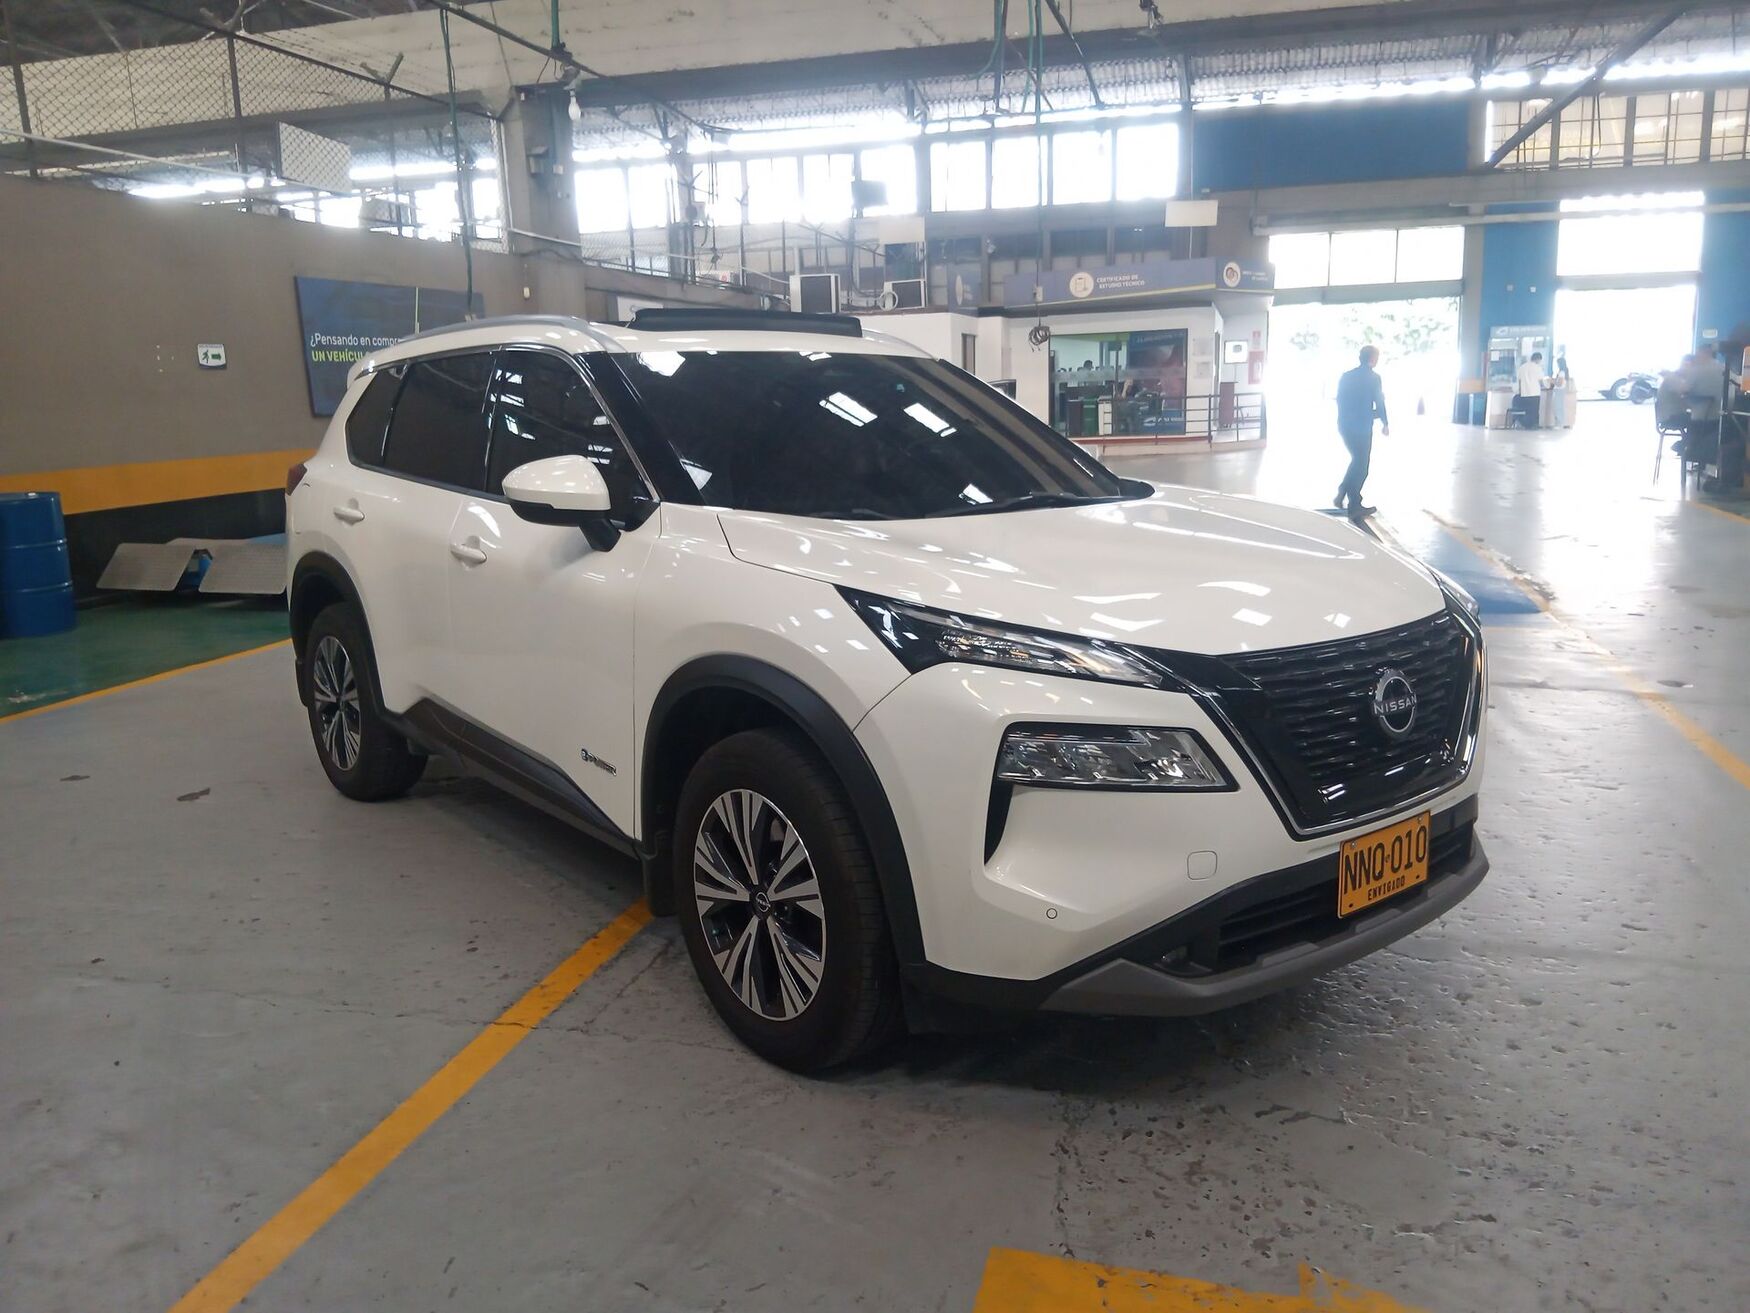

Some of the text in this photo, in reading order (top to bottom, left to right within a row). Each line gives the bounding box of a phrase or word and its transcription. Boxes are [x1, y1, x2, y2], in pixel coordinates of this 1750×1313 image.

[310, 332, 359, 348] ¿Pensando
[372, 337, 401, 347] compr
[311, 350, 326, 362] UN
[1373, 693, 1417, 715] NISSAN
[1367, 875, 1406, 901] ENVIGADO
